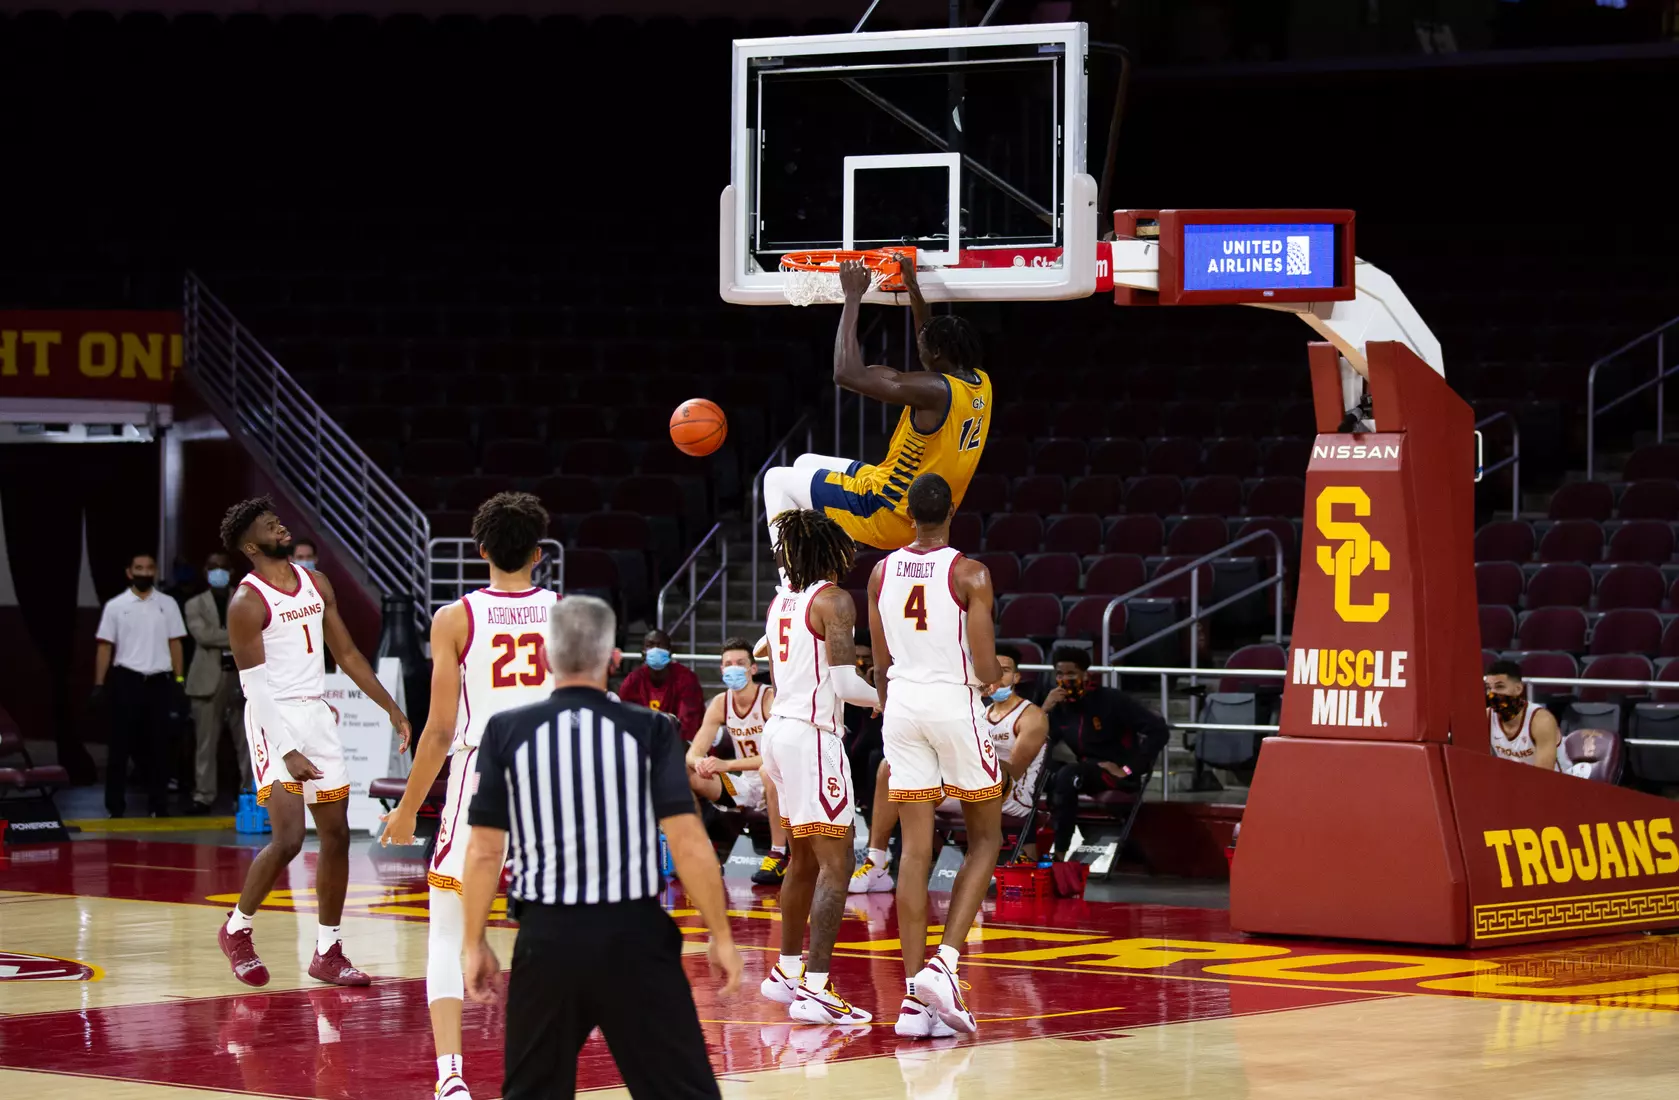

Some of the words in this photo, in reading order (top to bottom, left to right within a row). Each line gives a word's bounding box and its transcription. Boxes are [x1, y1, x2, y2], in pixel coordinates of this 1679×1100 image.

[1223, 240, 1283, 255] UNITED
[1207, 257, 1283, 273] AIRLINES
[958, 414, 984, 452] 12
[1313, 445, 1399, 459] NISSAN
[1316, 486, 1390, 622] SC
[279, 603, 322, 623] TROJANS
[488, 606, 548, 625] AGBONKPOLO
[904, 584, 928, 632] 4
[302, 624, 314, 654] 1
[778, 617, 792, 662] 5
[492, 633, 546, 689] 23
[1293, 648, 1408, 688] MUSCLE
[736, 740, 760, 758] 13
[827, 776, 841, 798] SC
[10, 821, 61, 831] POWERADE
[1483, 817, 1679, 889] TROJANS
